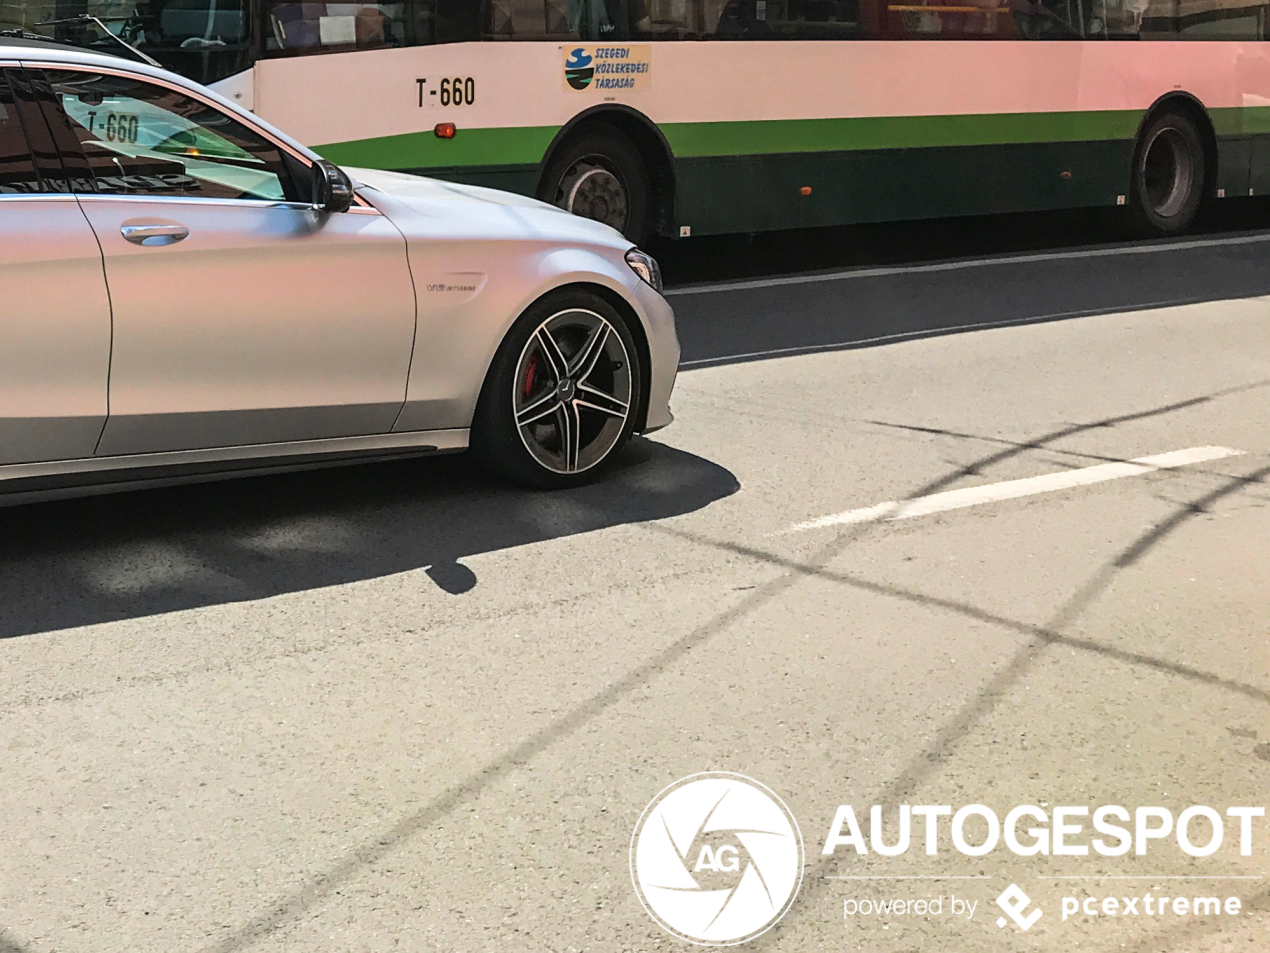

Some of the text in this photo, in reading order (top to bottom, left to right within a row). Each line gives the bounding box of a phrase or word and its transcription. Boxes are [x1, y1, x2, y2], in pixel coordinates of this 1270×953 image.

[594, 48, 630, 59] SZEGEDI
[415, 76, 475, 108] T-660
[594, 75, 635, 89] TÁRSASÁG
[88, 111, 139, 143] T-660
